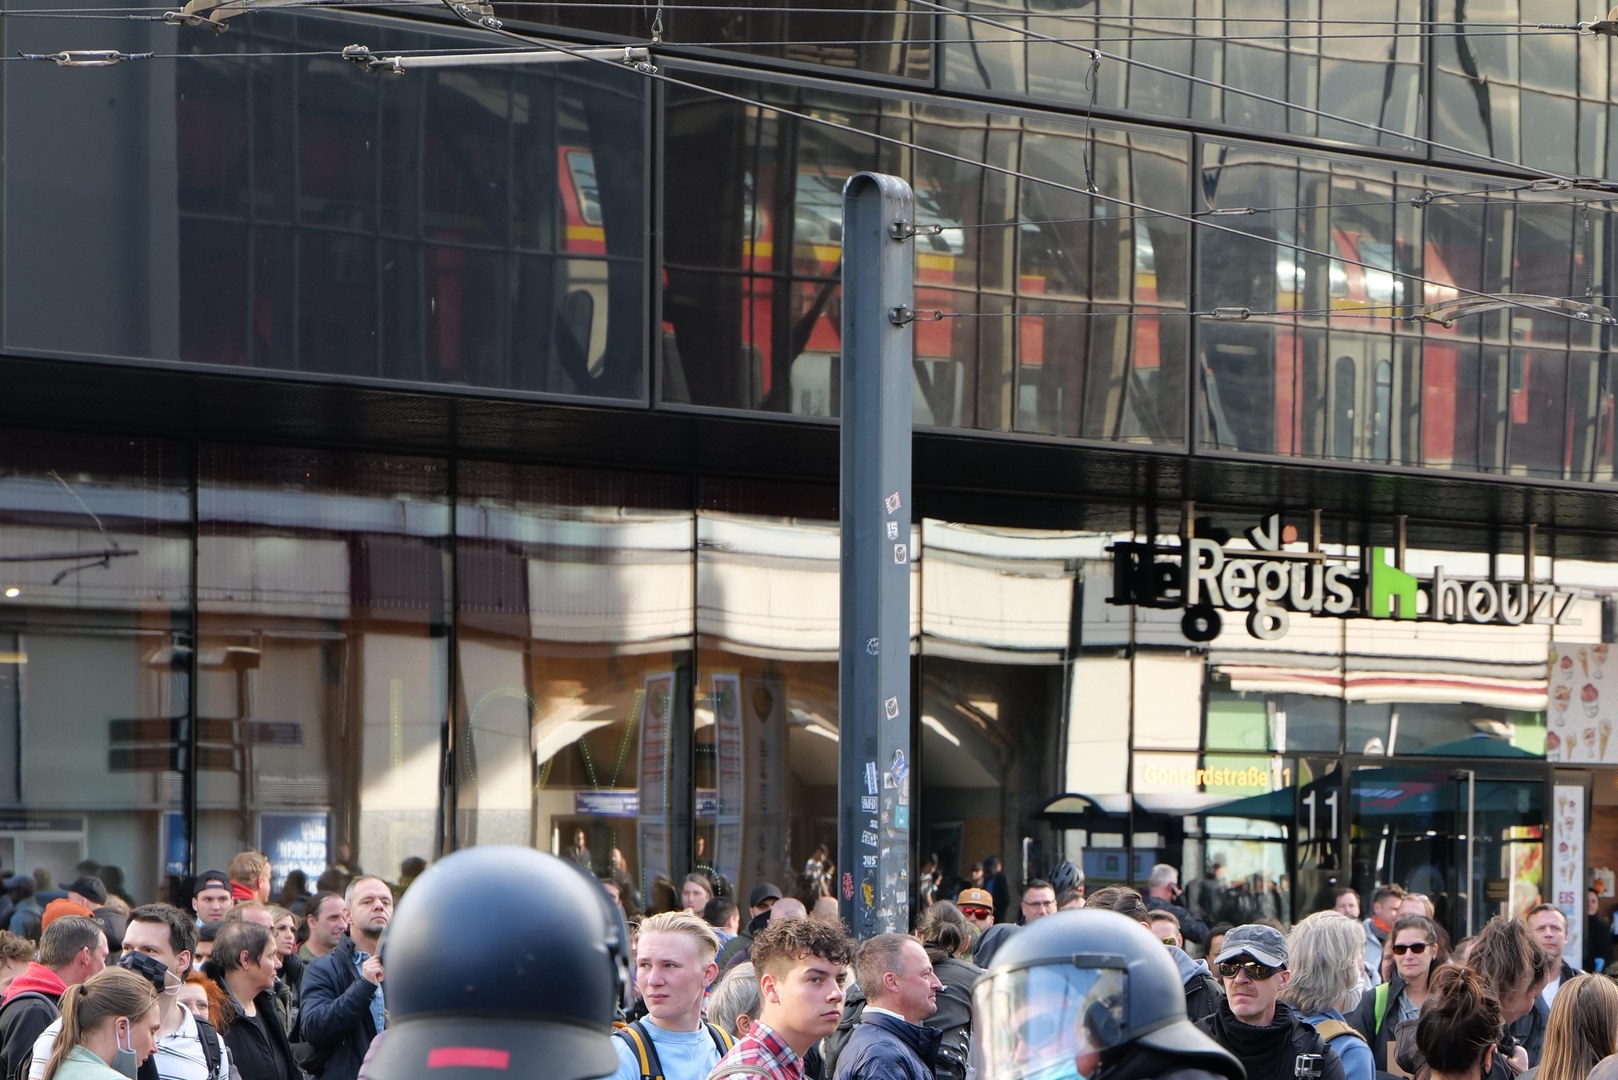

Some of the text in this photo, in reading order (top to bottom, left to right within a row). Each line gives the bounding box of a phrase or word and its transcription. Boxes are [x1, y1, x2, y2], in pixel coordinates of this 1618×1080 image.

[1188, 538, 1355, 640] Regus
[1435, 565, 1584, 626] houzz
[1144, 764, 1290, 787] Gontardstraße 11
[1303, 790, 1338, 839] 11
